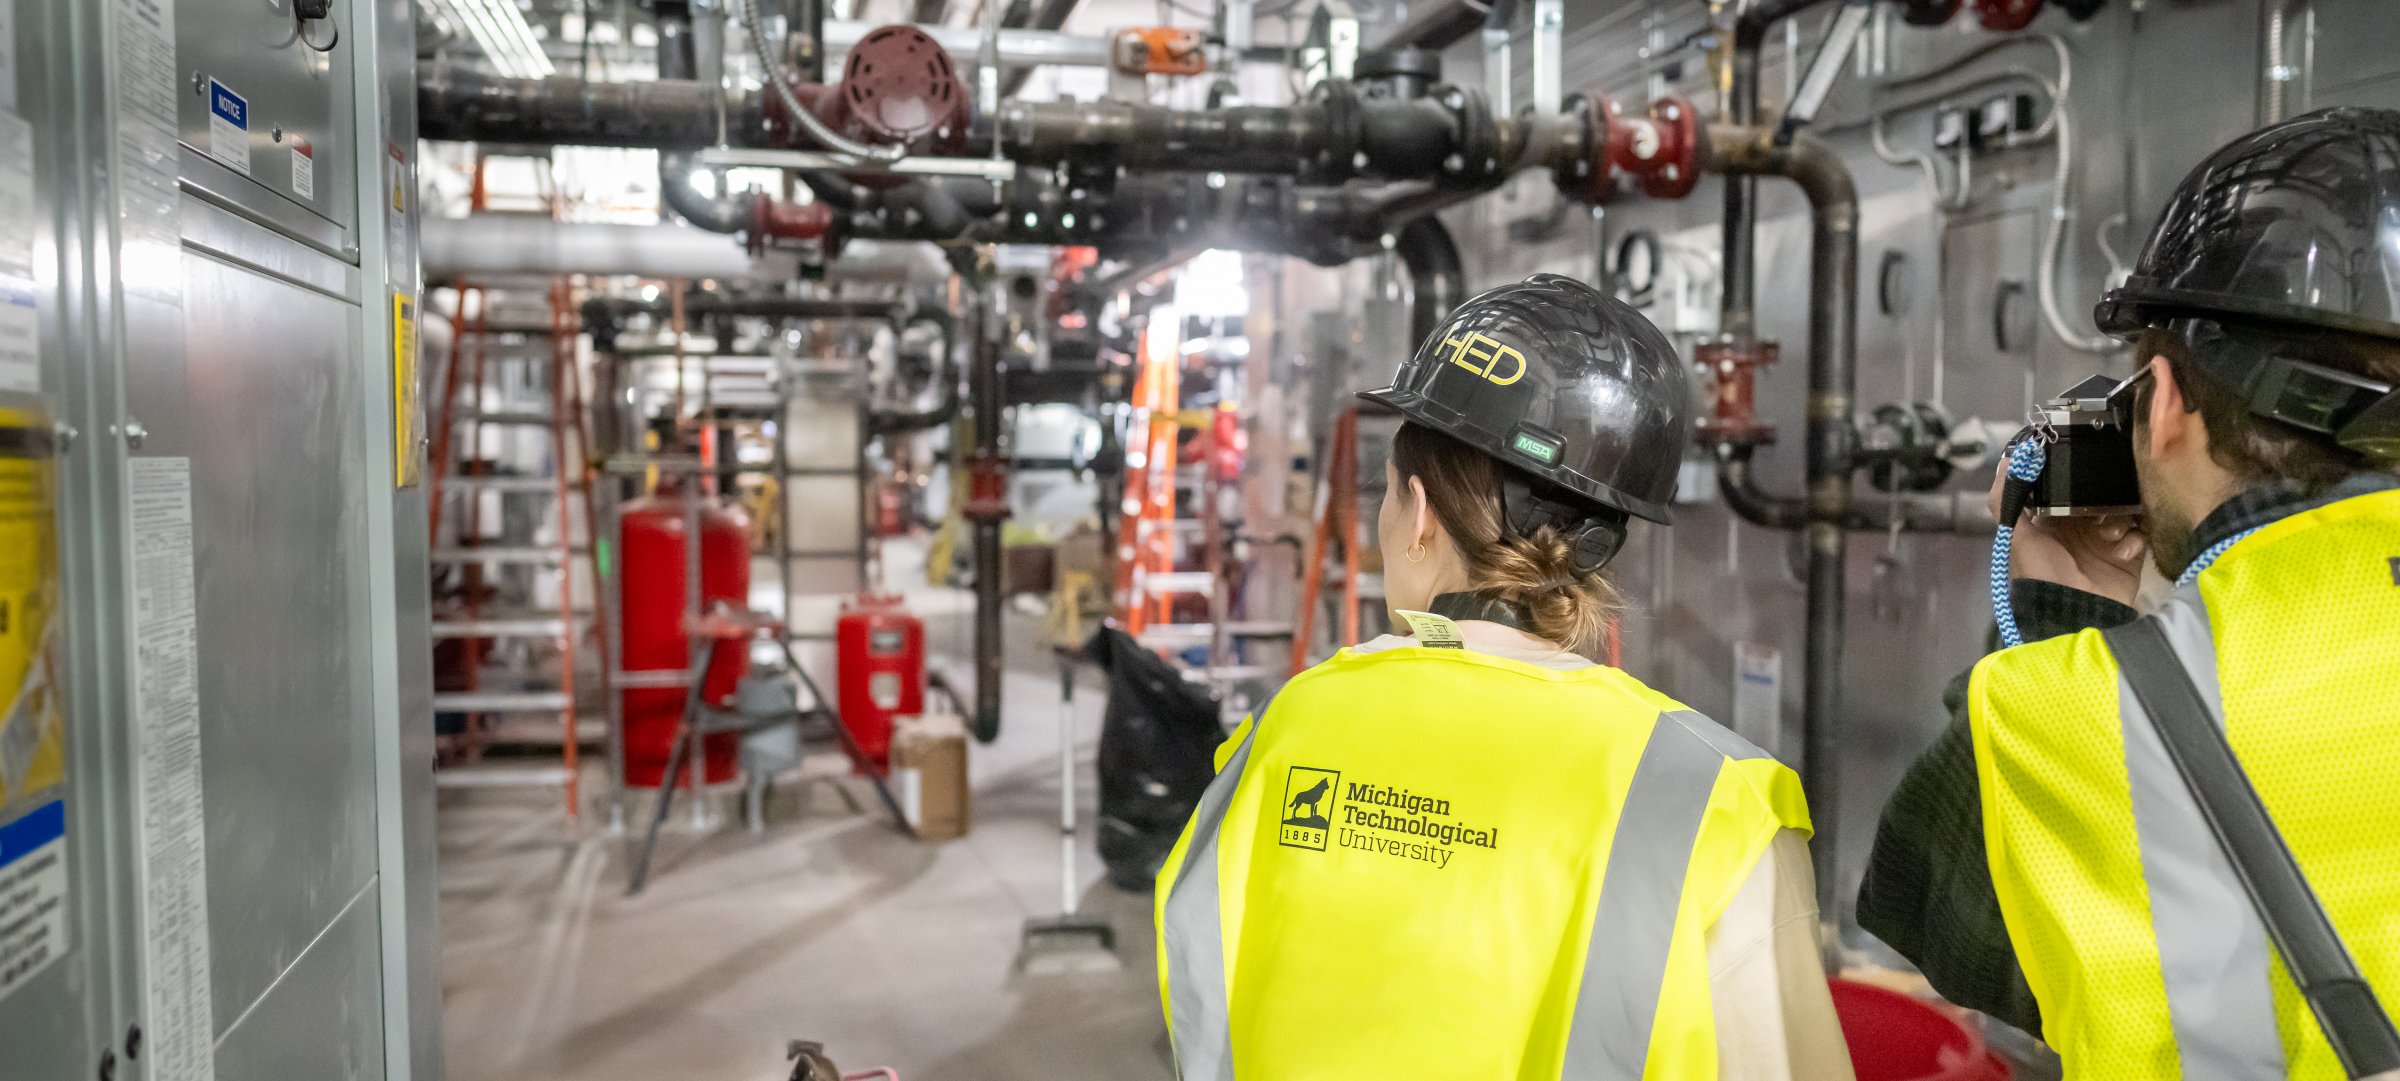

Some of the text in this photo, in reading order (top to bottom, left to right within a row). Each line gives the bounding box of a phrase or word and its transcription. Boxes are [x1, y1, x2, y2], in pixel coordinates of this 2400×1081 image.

[218, 94, 240, 120] NOTICE
[1435, 325, 1526, 386] HED
[1519, 436, 1553, 459] MSA
[1345, 782, 1450, 816] Michigan
[1284, 829, 1321, 844] 1885
[1343, 805, 1498, 849] Technological
[1339, 827, 1454, 869] University
